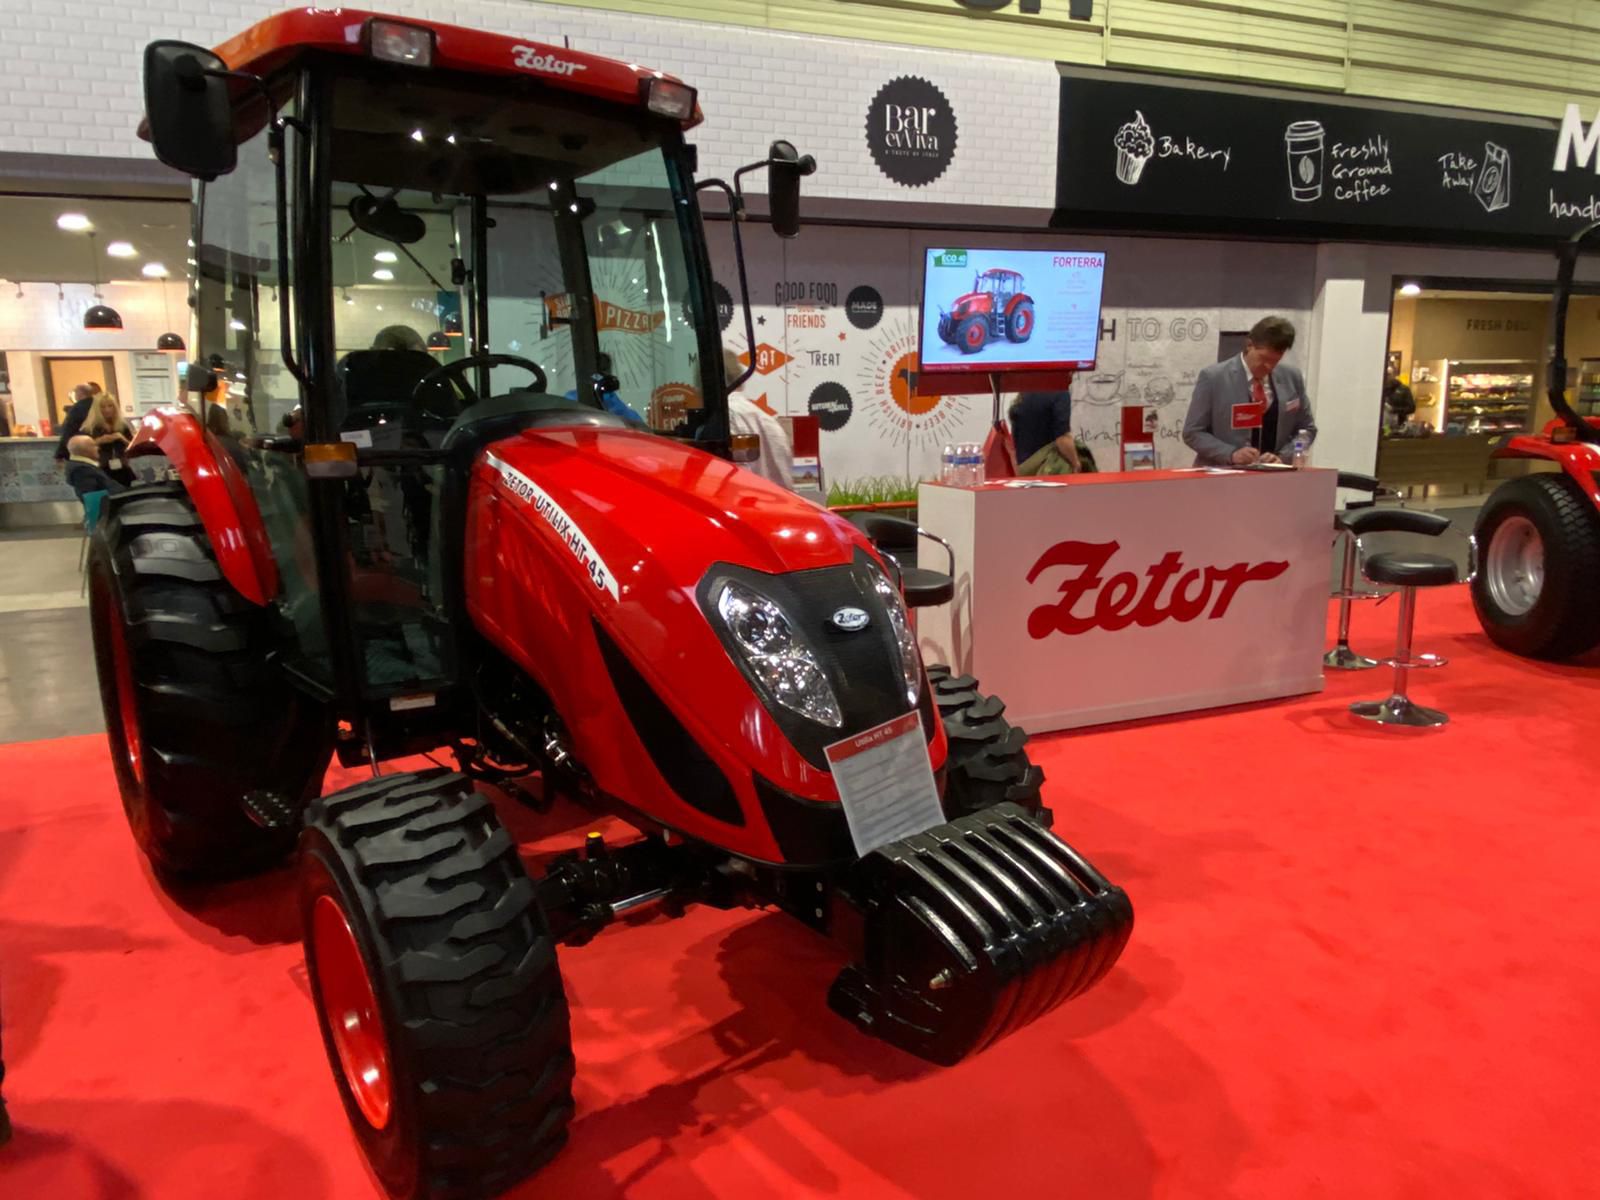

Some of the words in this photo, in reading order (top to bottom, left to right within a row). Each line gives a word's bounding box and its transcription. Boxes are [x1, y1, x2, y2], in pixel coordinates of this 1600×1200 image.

[511, 44, 587, 75] Zetor
[885, 104, 937, 135] Bar
[1158, 136, 1231, 171] Bakery
[1438, 153, 1477, 171] Take
[1332, 159, 1392, 179] Ground
[1335, 178, 1391, 202] Coffee
[1443, 171, 1474, 193] Away
[1053, 256, 1103, 268] FORTERRA
[775, 281, 805, 307] GOOD
[810, 281, 838, 307] FOOD
[606, 305, 650, 330] PIZZA
[787, 314, 826, 329] FRIENDS
[1127, 317, 1160, 342] TO
[1169, 317, 1208, 342] GO
[1466, 319, 1502, 331] FRESH
[755, 350, 776, 370] AT
[806, 350, 841, 366] TREAT
[504, 471, 534, 502] ZETOR
[535, 495, 570, 537] UTILIX
[570, 532, 587, 561] HT
[588, 559, 606, 589] 45
[1026, 540, 1290, 640] Zetor
